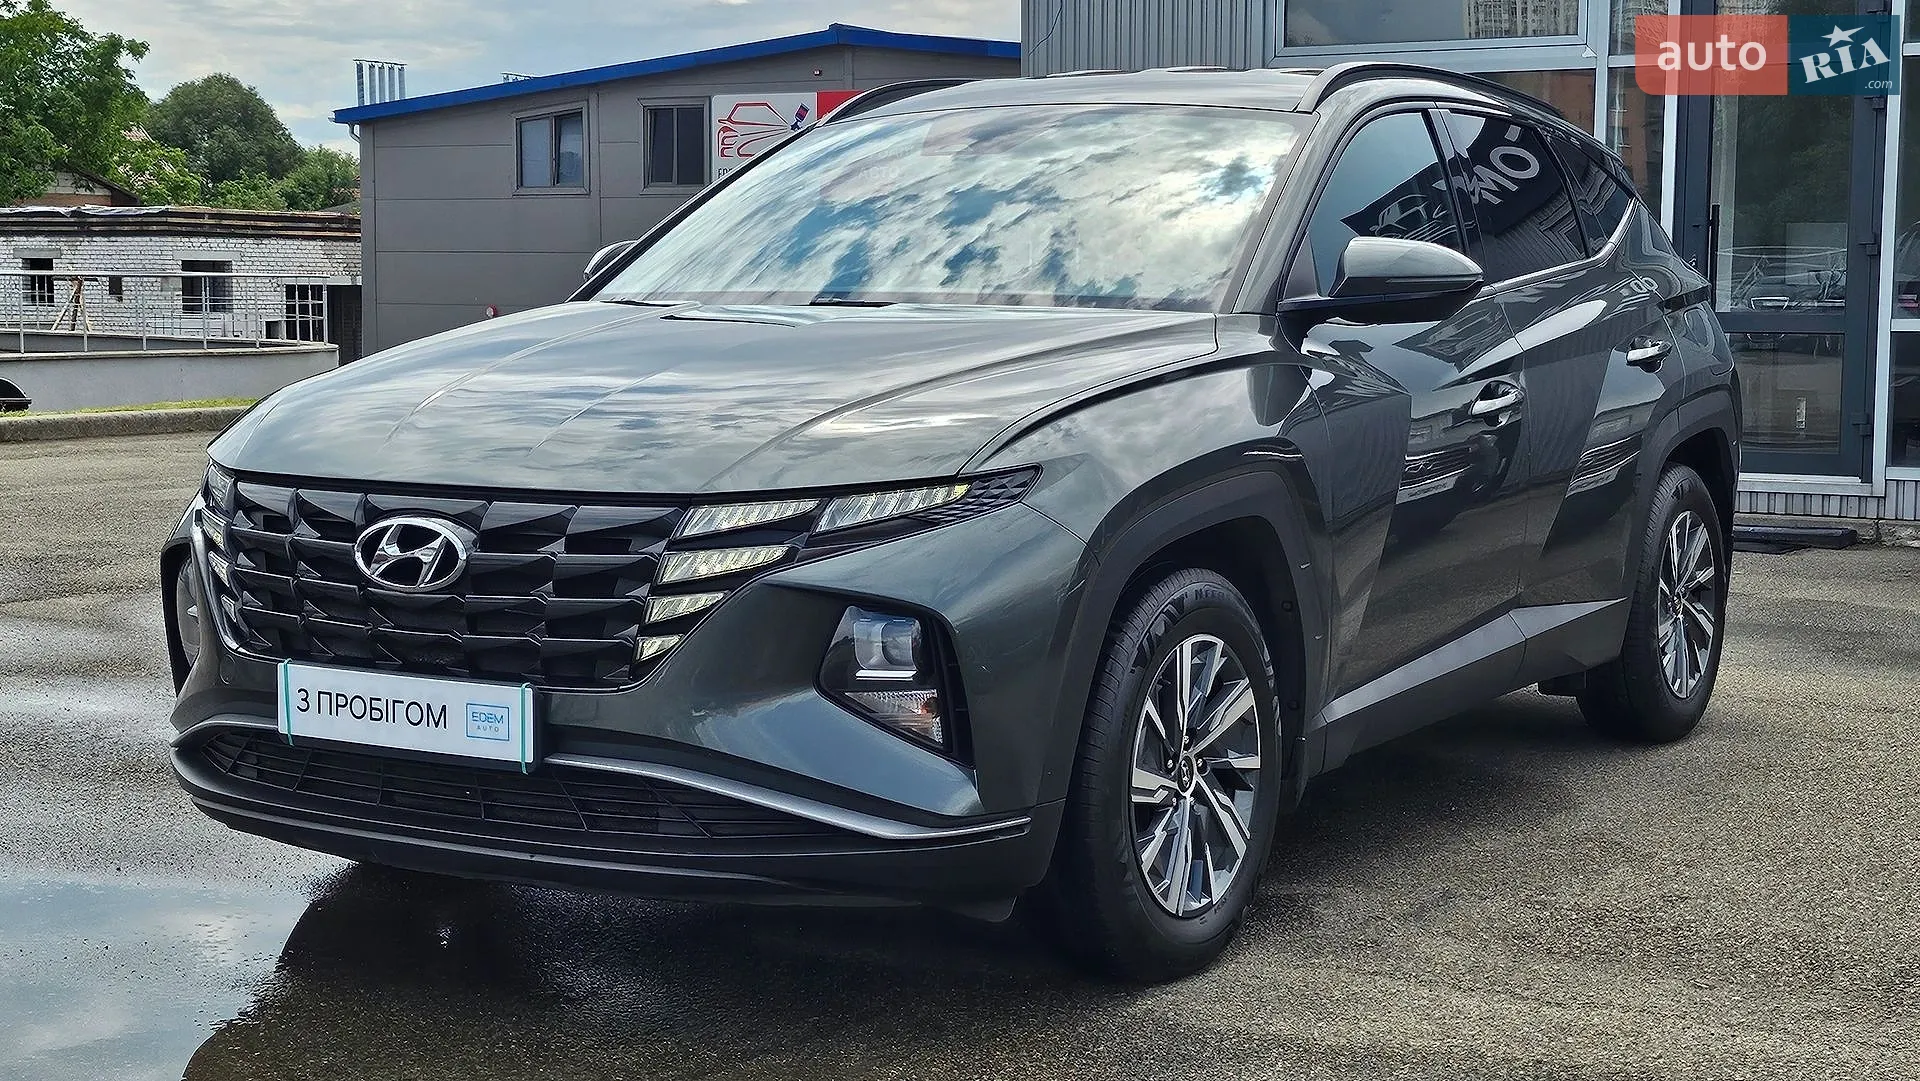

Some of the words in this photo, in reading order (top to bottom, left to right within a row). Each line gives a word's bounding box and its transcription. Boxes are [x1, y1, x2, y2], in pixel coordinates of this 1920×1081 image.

[317, 690, 448, 730] ПРОБІГОМ
[471, 711, 504, 725] EDEM
[476, 724, 500, 733] AUTO
